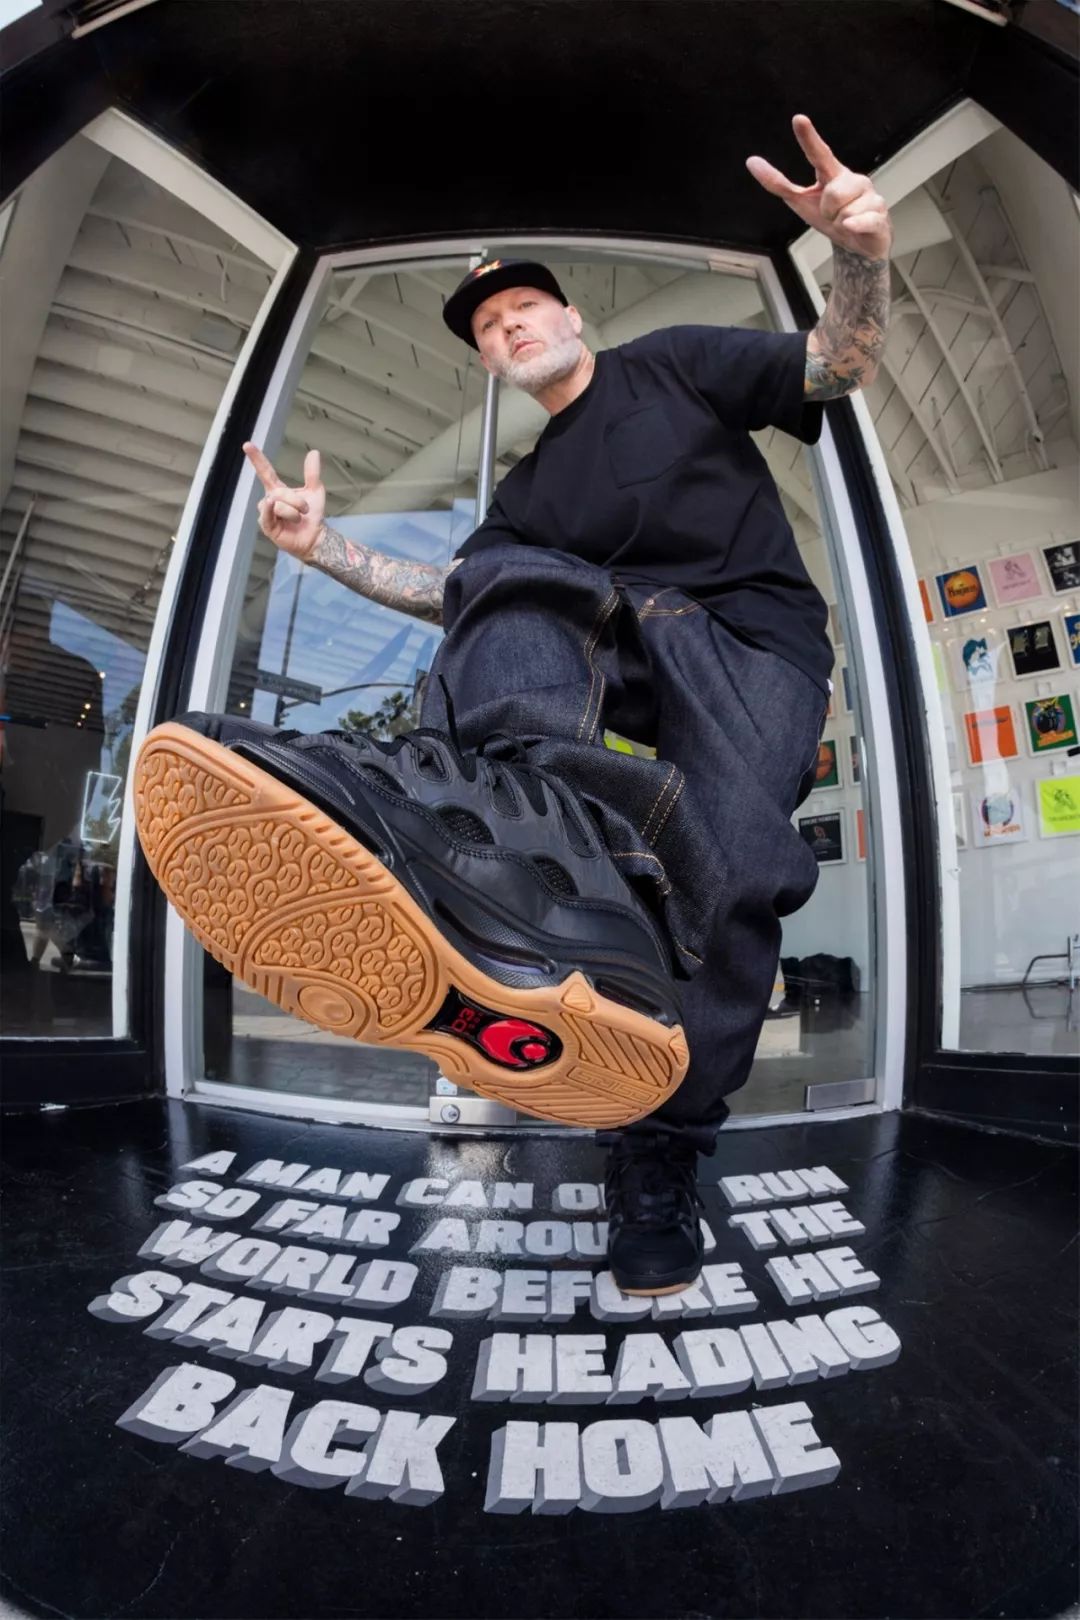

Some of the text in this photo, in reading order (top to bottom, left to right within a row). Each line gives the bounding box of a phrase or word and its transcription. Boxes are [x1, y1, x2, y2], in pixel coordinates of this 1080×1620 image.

[154, 1180, 261, 1219] SO
[250, 1198, 401, 1248] FAR
[728, 1201, 866, 1251] THE
[180, 1150, 237, 1175] A
[236, 1158, 391, 1201] MAN
[396, 1177, 534, 1210] CAN
[718, 1165, 850, 1208] RUN
[136, 1219, 419, 1310] WORLD
[765, 1246, 881, 1307] HE
[86, 1270, 901, 1404] STARTS HEADING
[115, 1362, 842, 1516] BACK HOME
